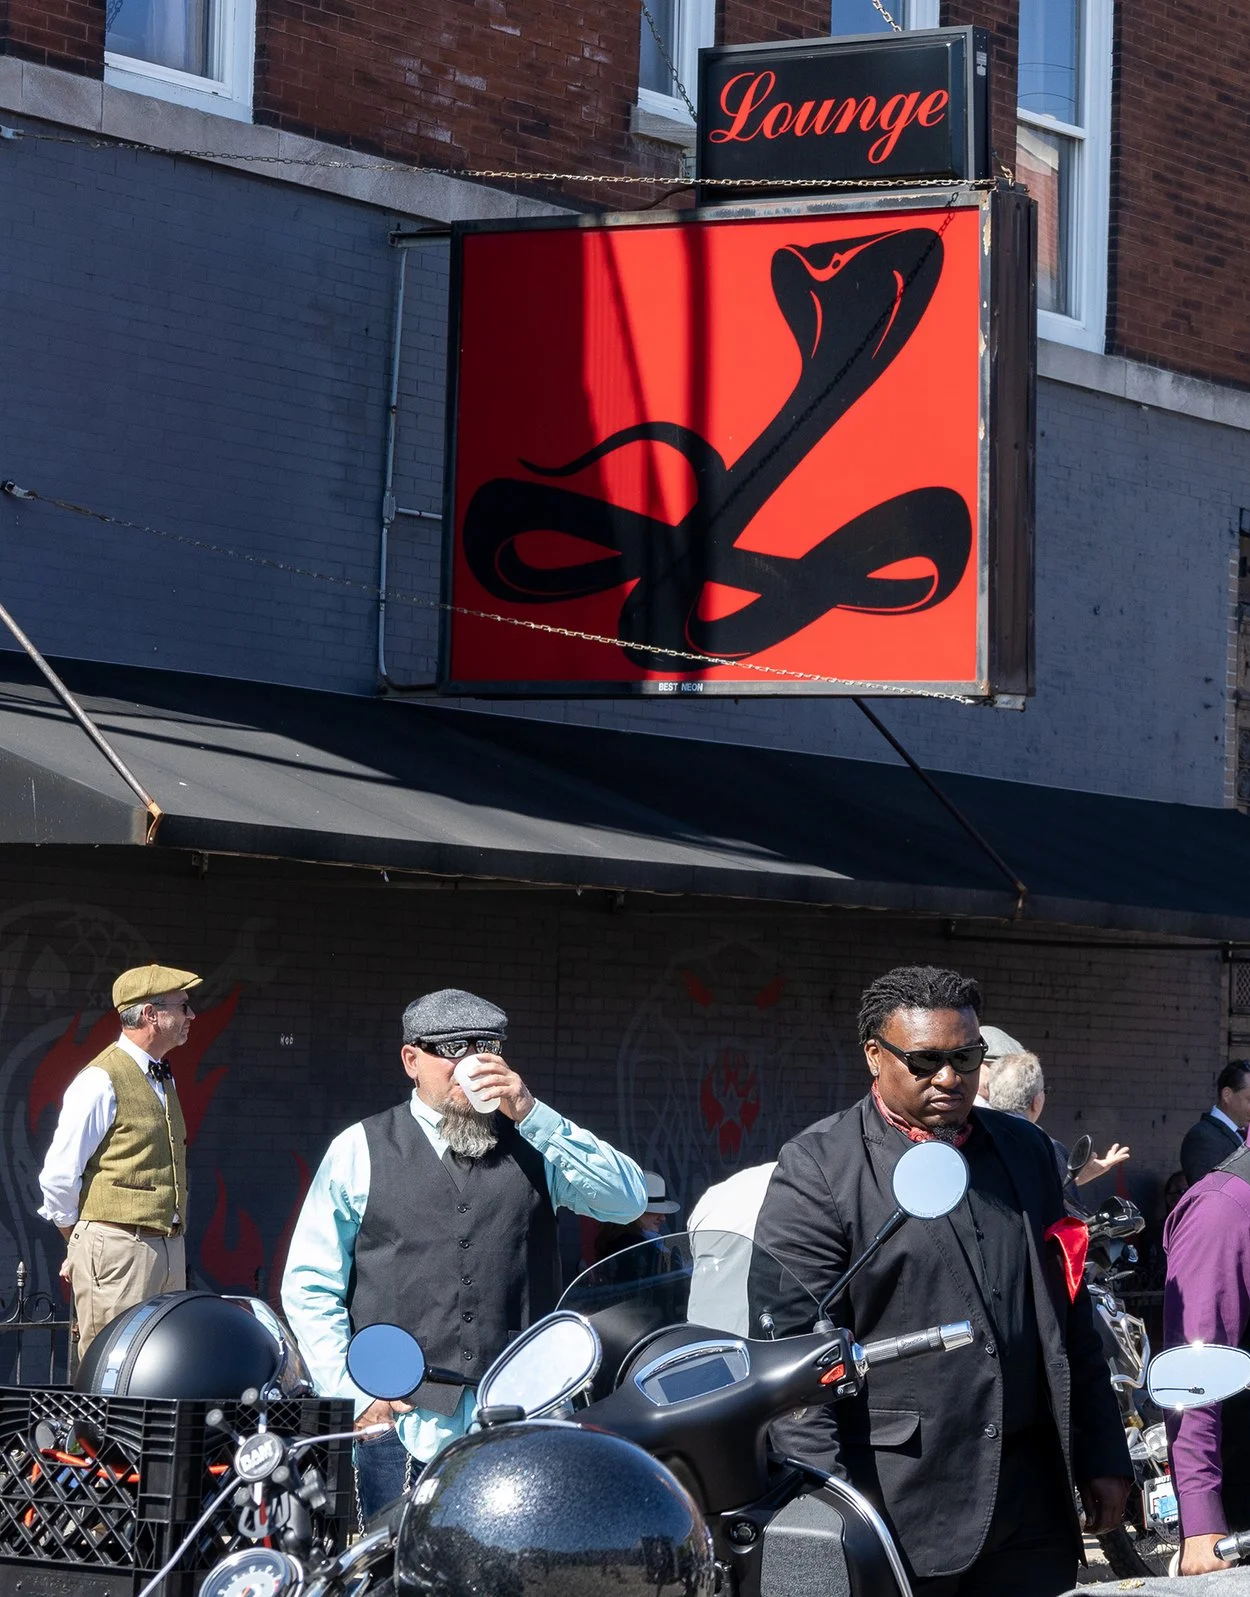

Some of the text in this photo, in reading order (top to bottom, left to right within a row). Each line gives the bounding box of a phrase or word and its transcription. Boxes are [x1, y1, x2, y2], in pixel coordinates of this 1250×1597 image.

[708, 70, 950, 165] Lounge
[658, 682, 704, 692] BEST NEON
